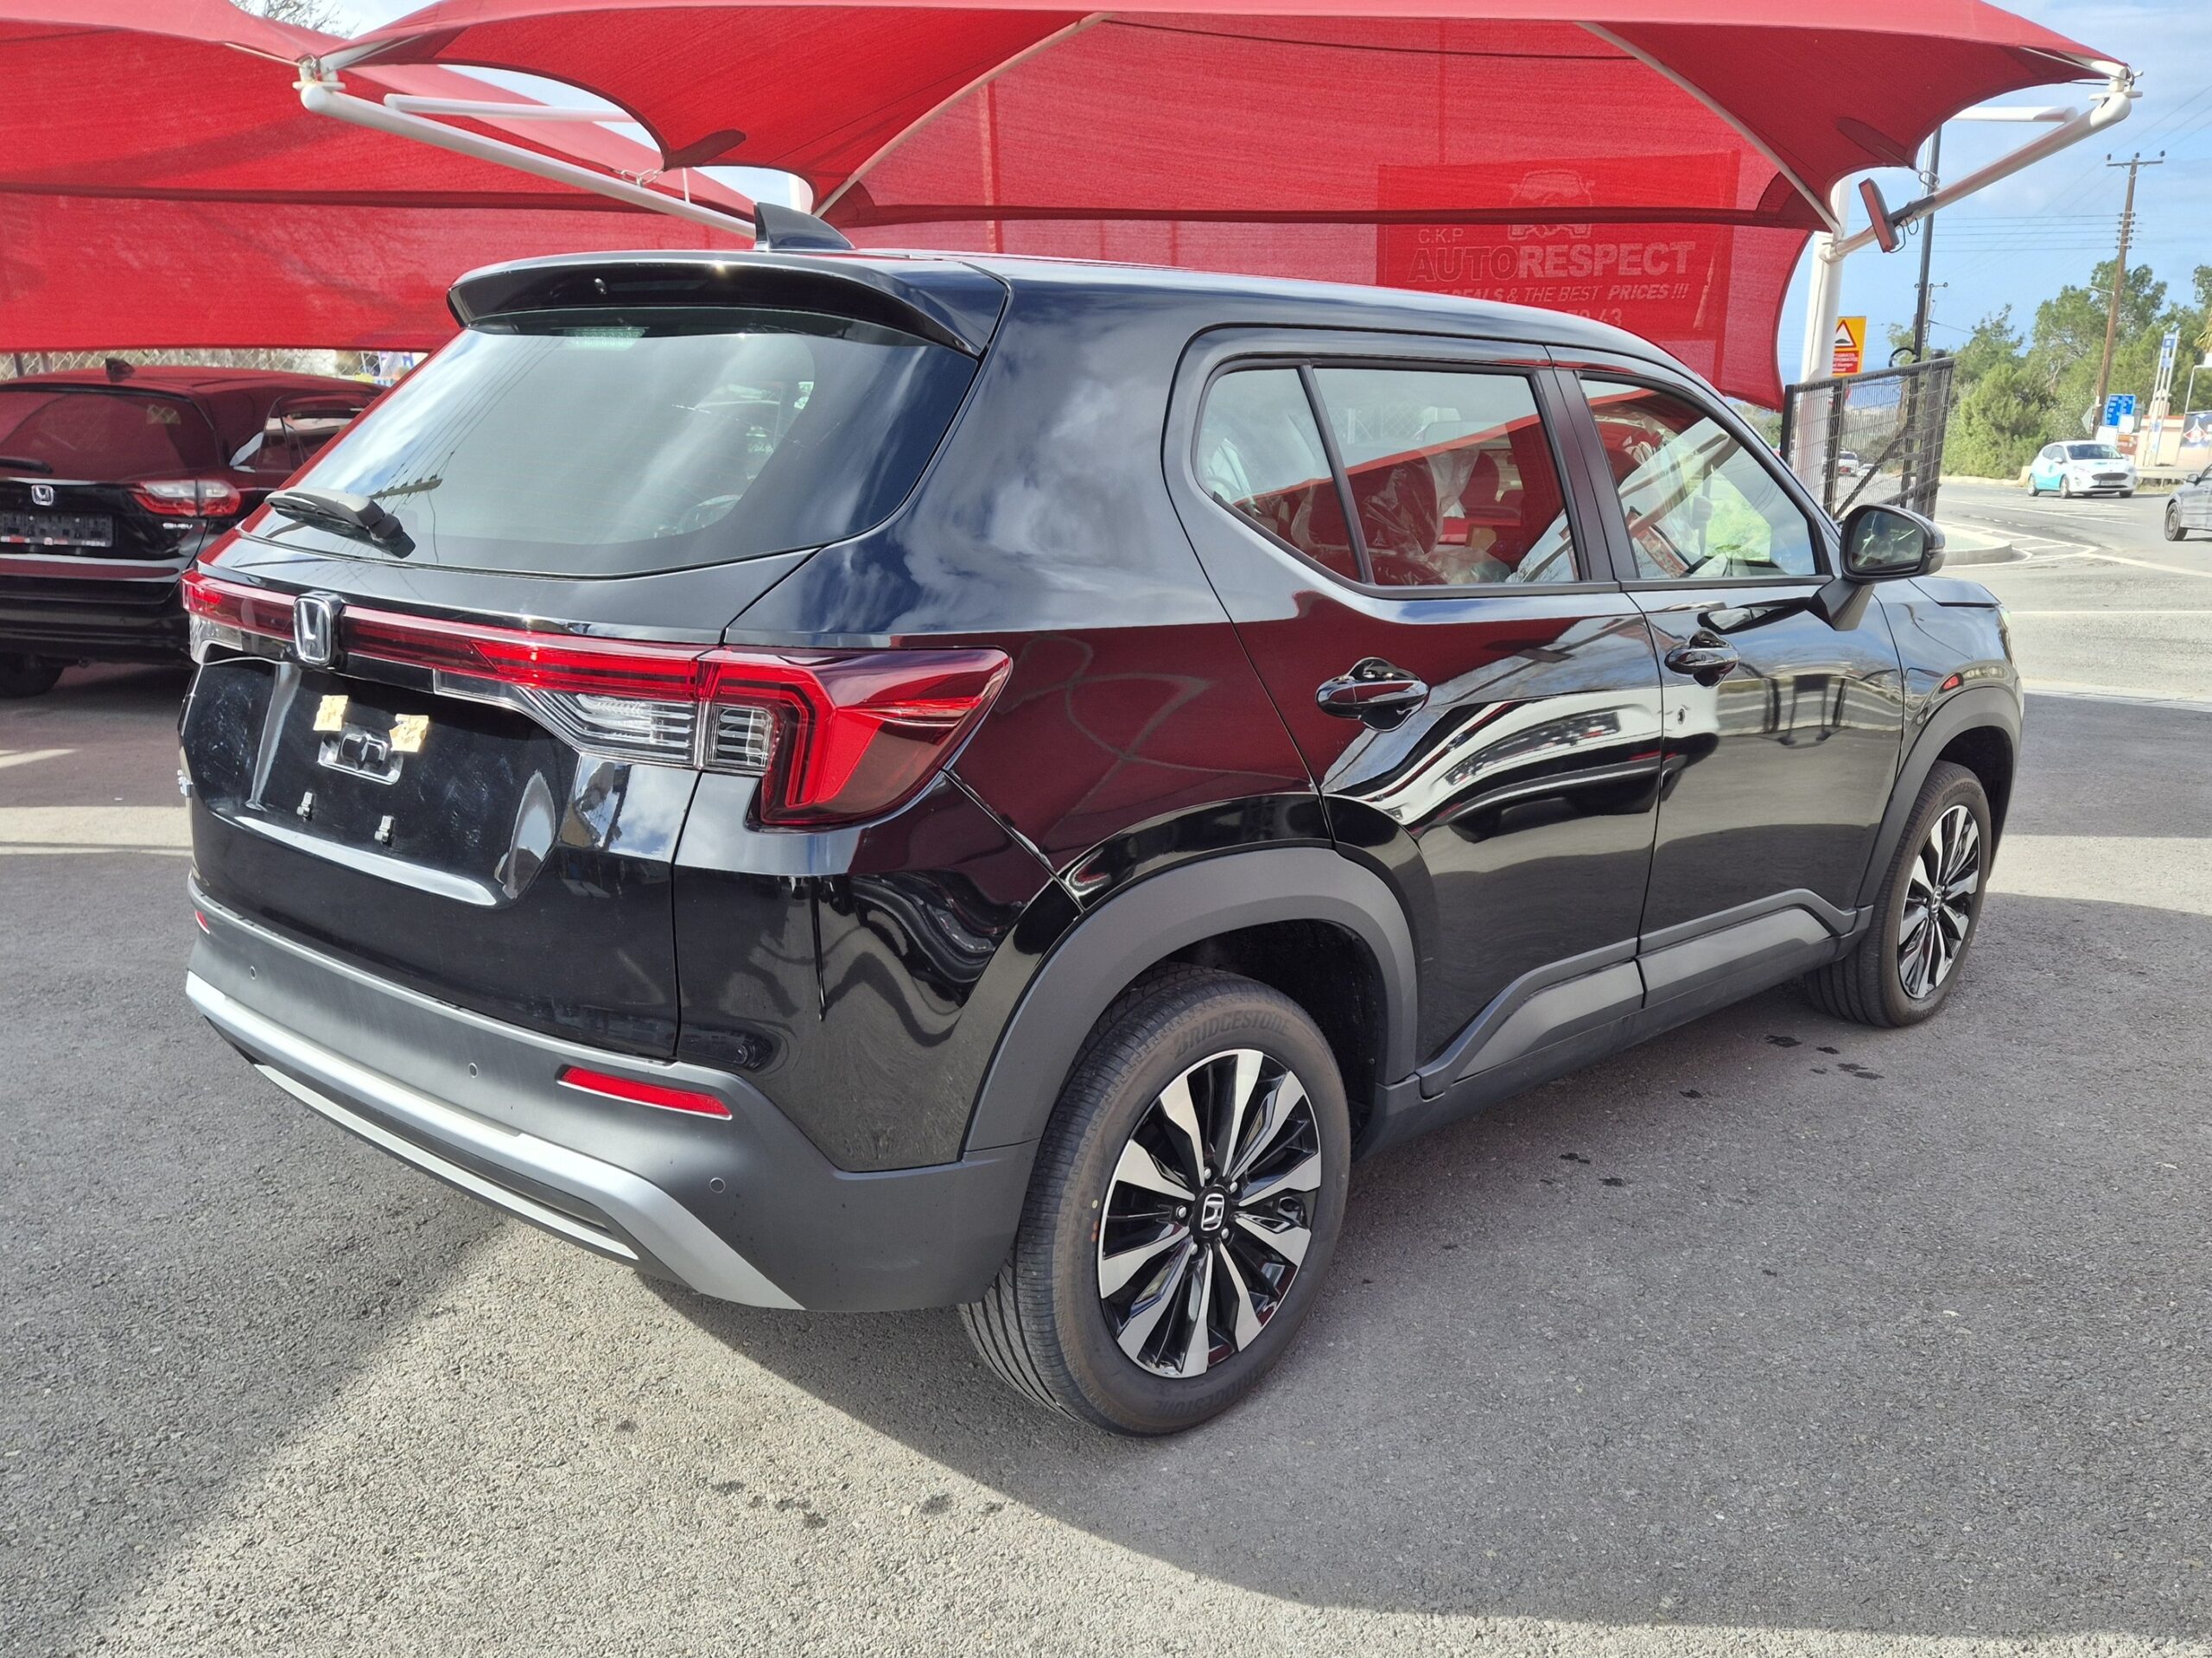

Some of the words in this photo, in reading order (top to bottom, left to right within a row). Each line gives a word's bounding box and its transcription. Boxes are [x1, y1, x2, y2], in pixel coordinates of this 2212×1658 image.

[1418, 228, 1464, 244] C.K.P
[1408, 242, 1695, 282] AUTORESPECT
[1506, 287, 1518, 302] &
[1523, 286, 1556, 302] THE
[1558, 286, 1603, 302] BEST
[1607, 284, 1669, 300] PRICES
